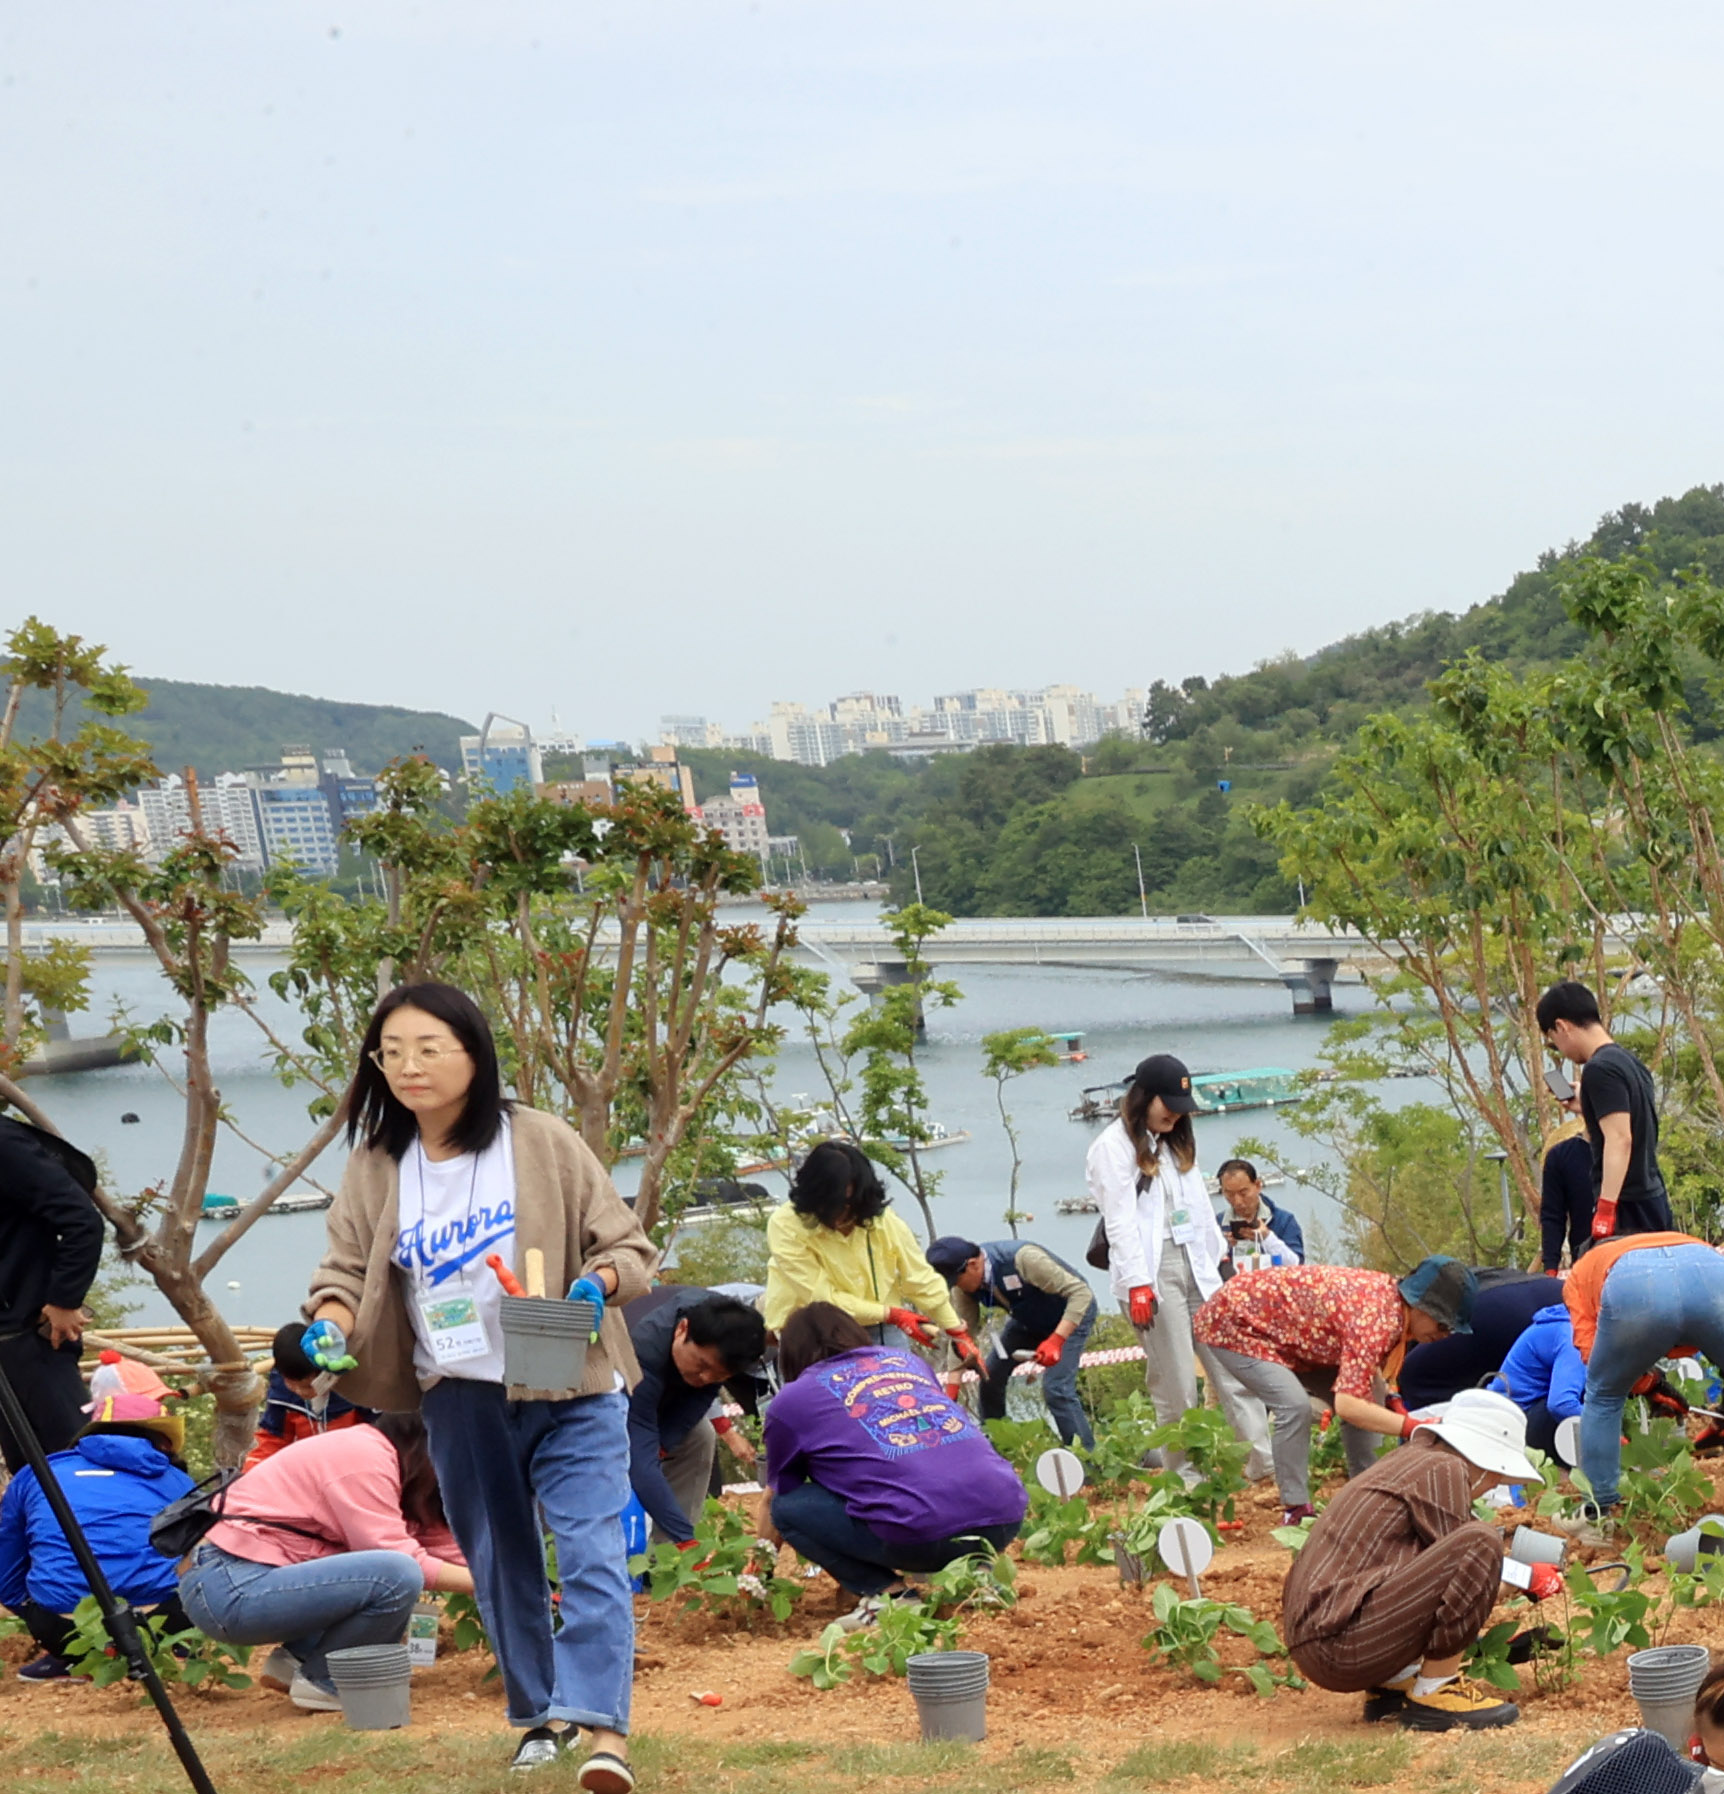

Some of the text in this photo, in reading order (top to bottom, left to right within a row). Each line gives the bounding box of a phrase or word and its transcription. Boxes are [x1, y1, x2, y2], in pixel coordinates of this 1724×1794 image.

[398, 1200, 514, 1268] Aurora
[436, 1336, 455, 1351] 52
[873, 1382, 914, 1398] RETRO
[878, 1408, 920, 1428] MICHAEL
